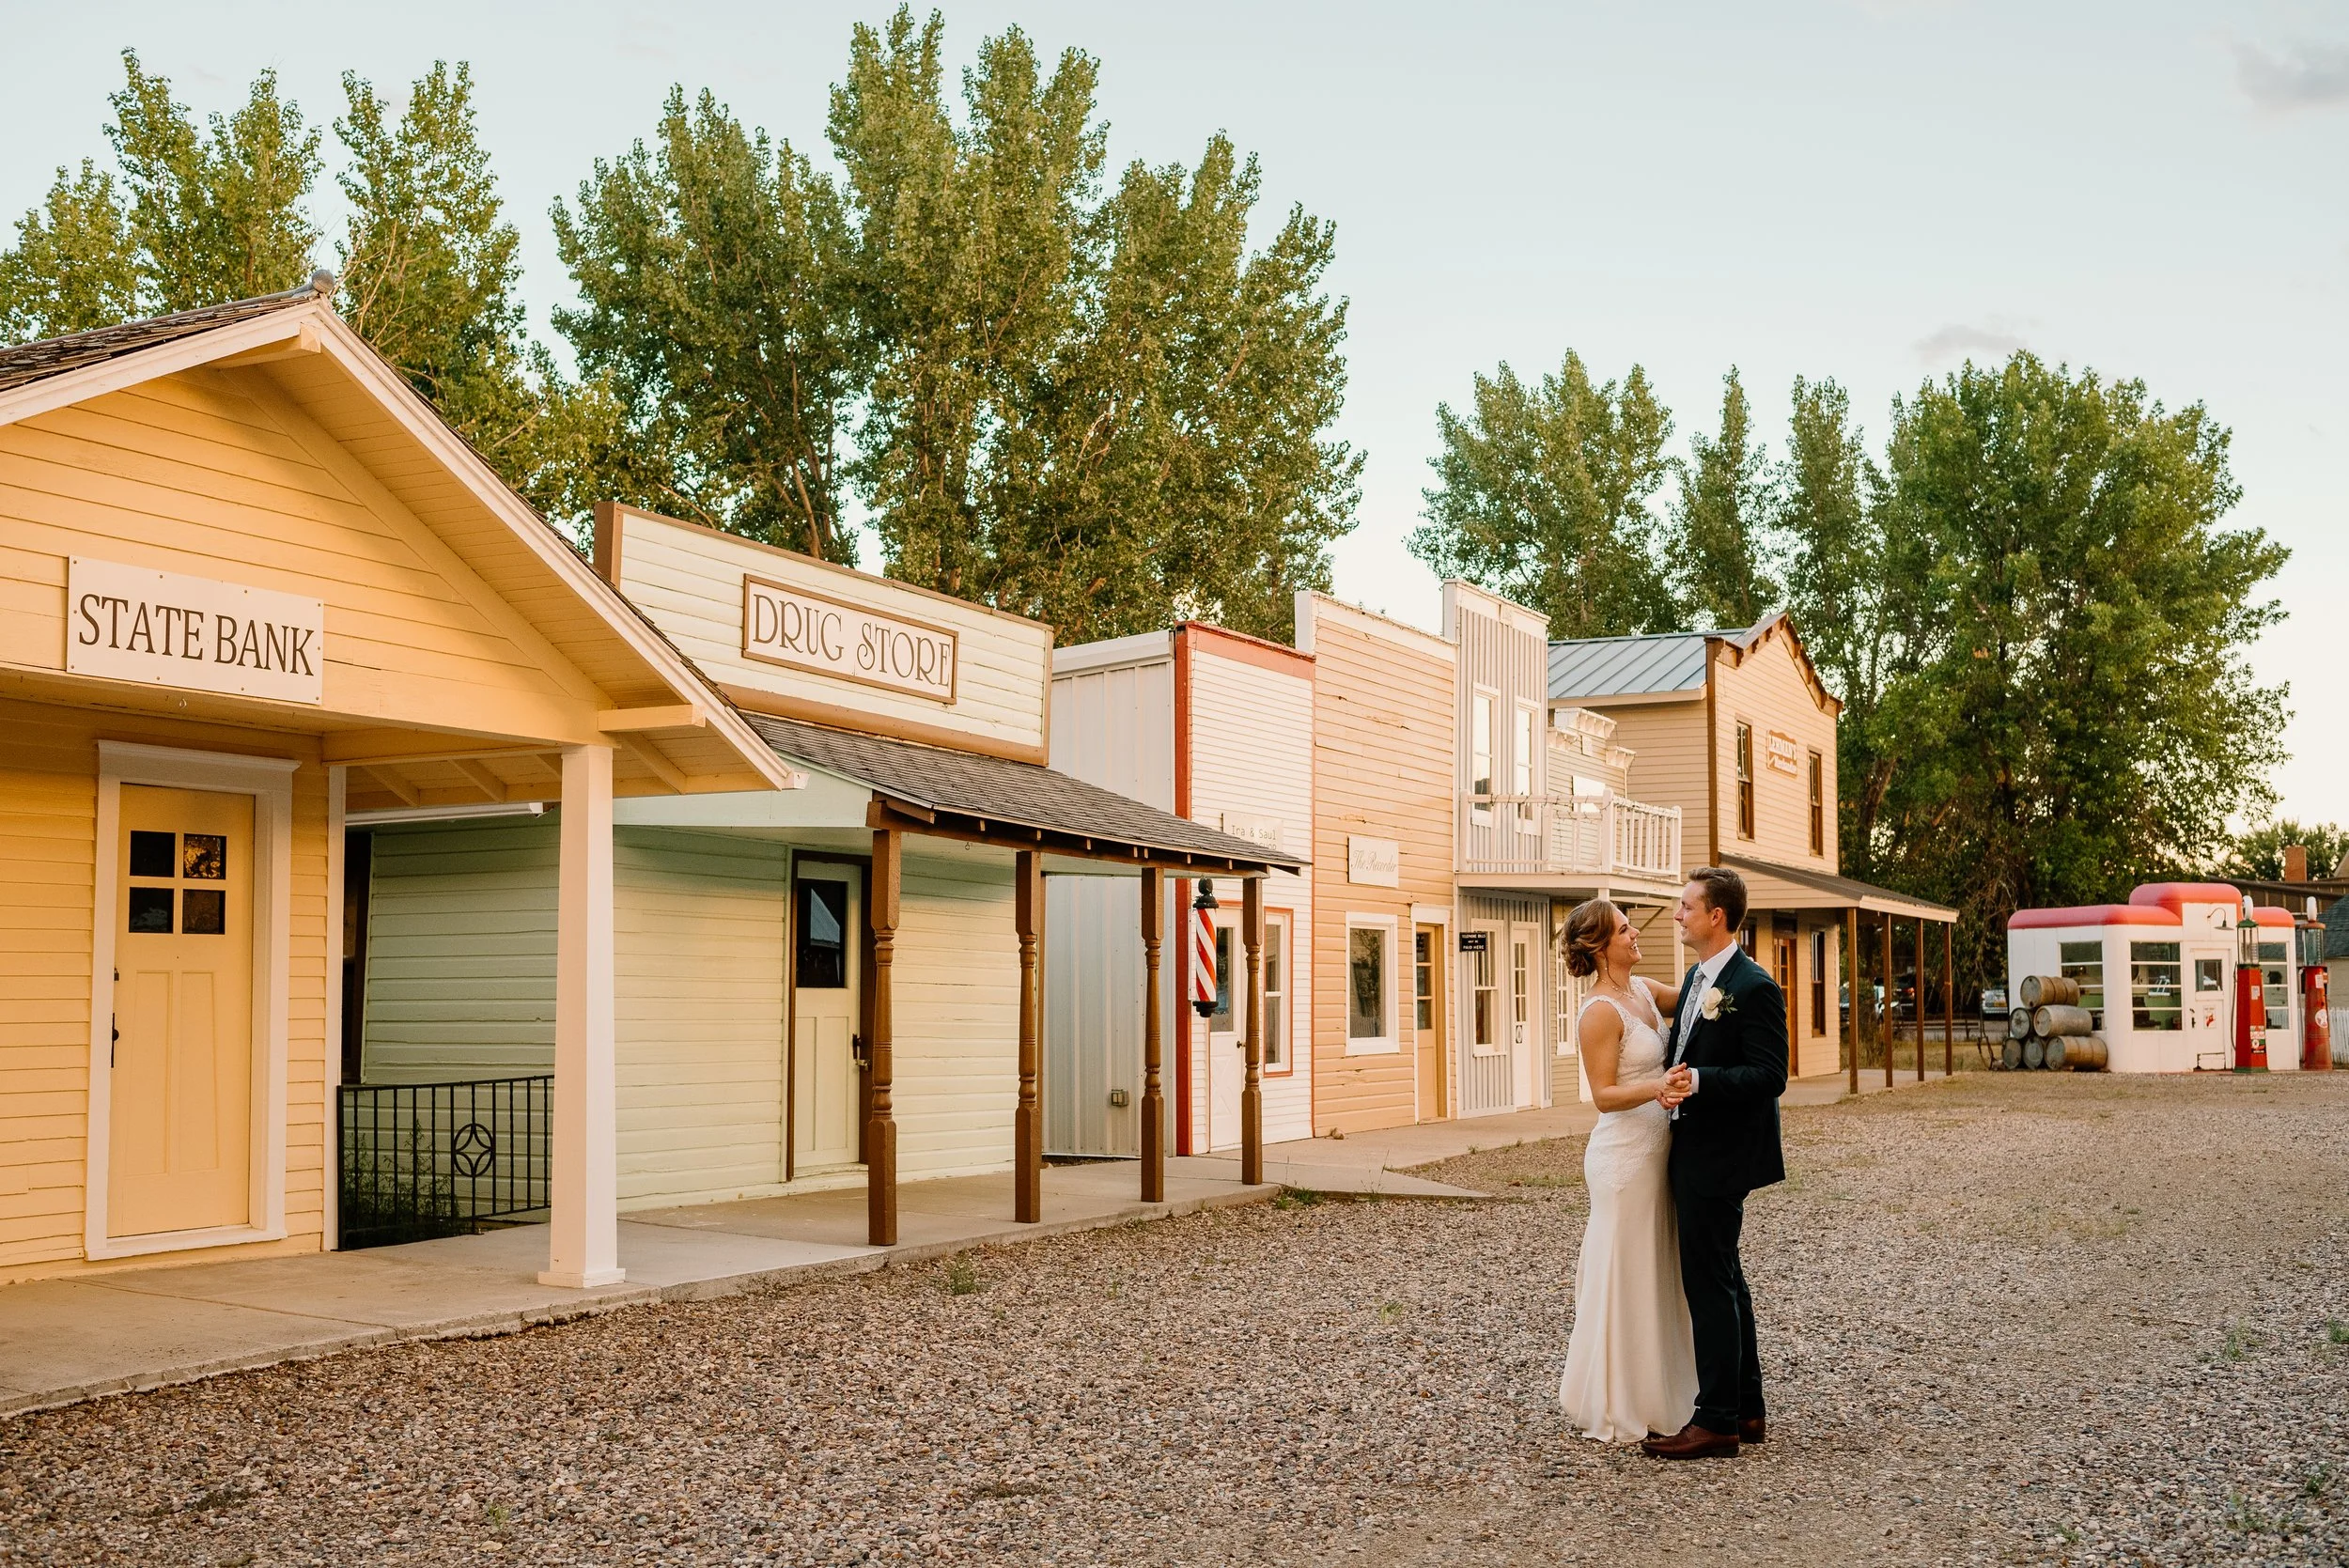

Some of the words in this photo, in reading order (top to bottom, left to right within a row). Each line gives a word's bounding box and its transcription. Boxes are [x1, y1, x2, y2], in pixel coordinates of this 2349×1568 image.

[79, 593, 204, 660] STATE
[214, 614, 314, 676] BANK
[753, 594, 844, 661] DRUG
[857, 622, 951, 688] STORE
[1231, 825, 1245, 836] Ira
[1250, 827, 1254, 837] &
[1259, 829, 1276, 840] Saul
[1351, 850, 1365, 870] The
